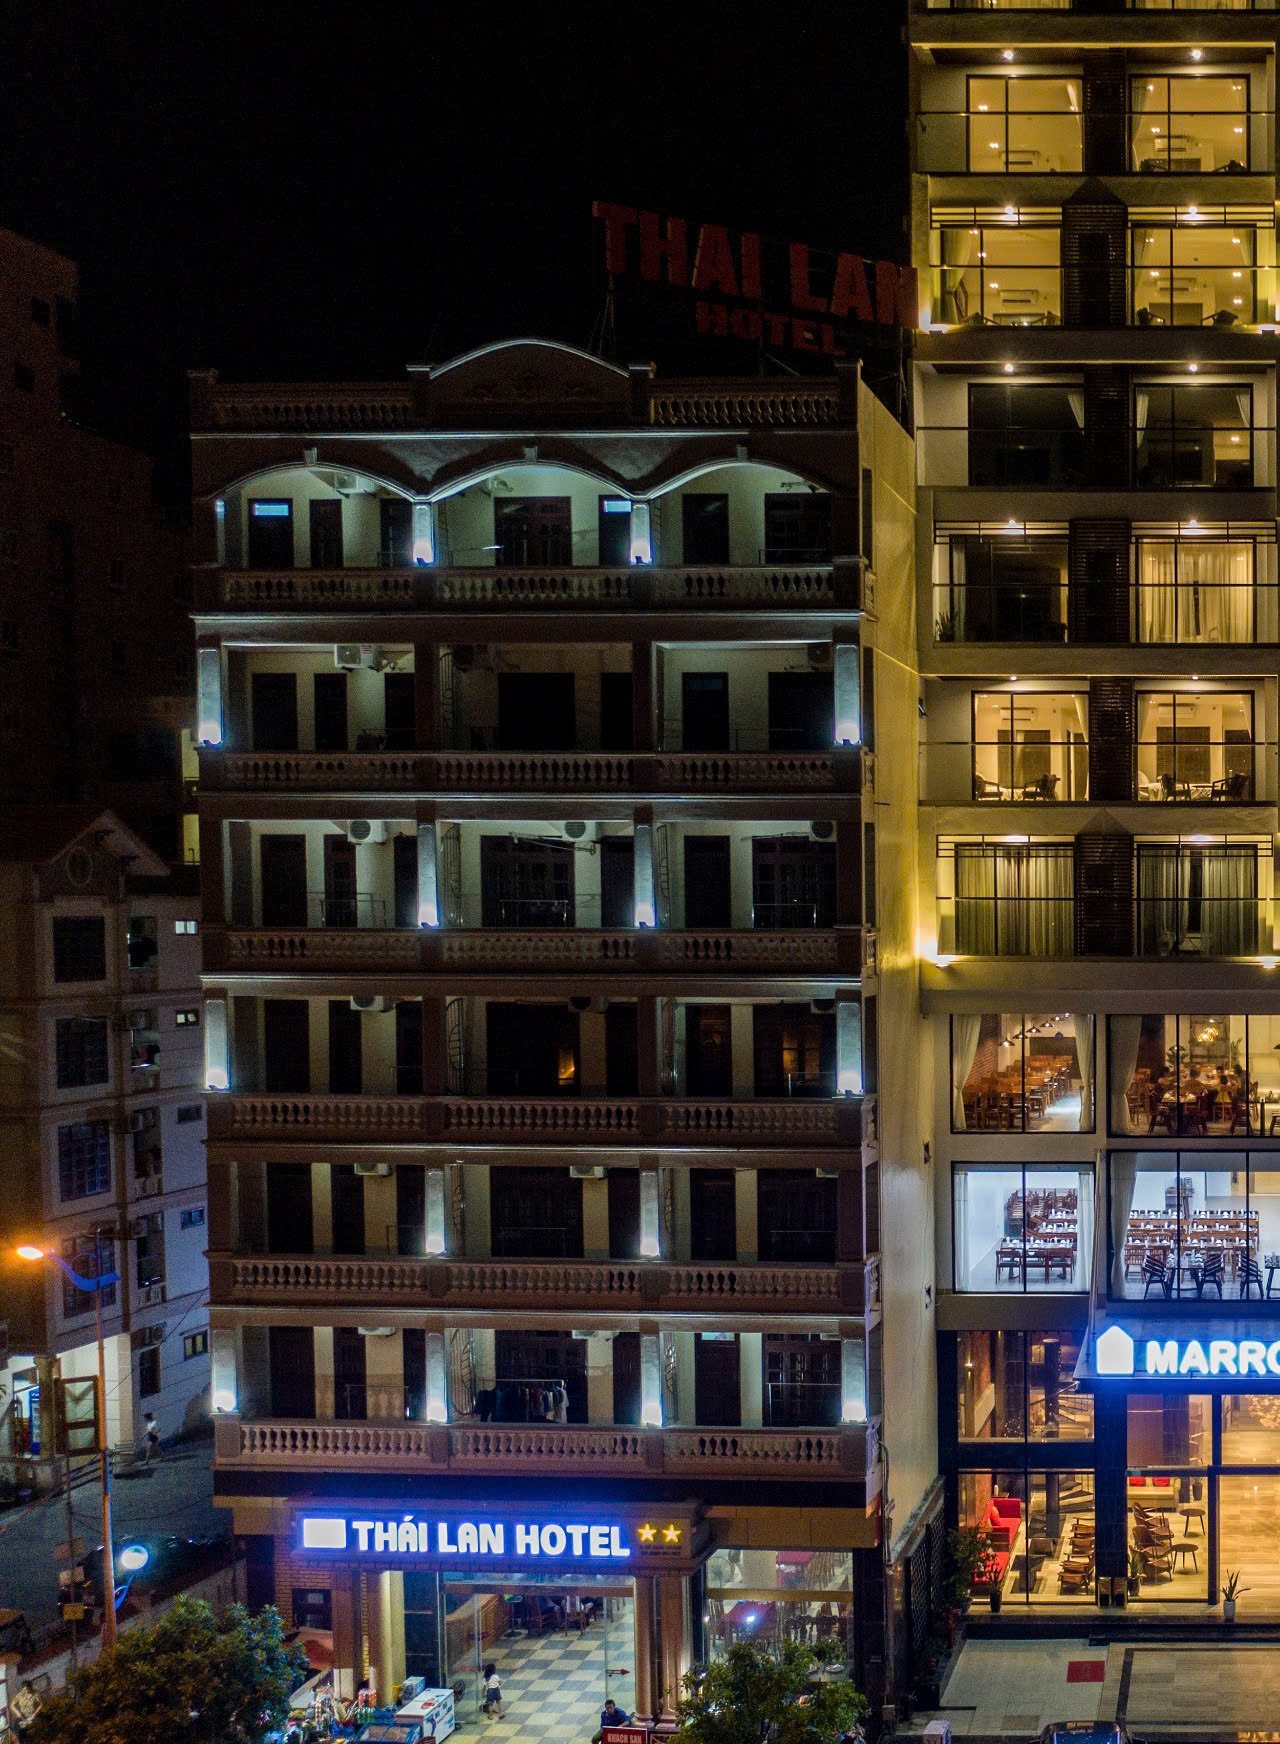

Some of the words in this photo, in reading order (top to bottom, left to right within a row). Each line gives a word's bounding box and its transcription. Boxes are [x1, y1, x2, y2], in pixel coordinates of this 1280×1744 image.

[789, 243, 919, 330] LAN
[695, 299, 847, 357] HOTEL
[352, 1515, 429, 1553] THÁI
[437, 1522, 505, 1555] LAN
[515, 1524, 631, 1557] HOTEL
